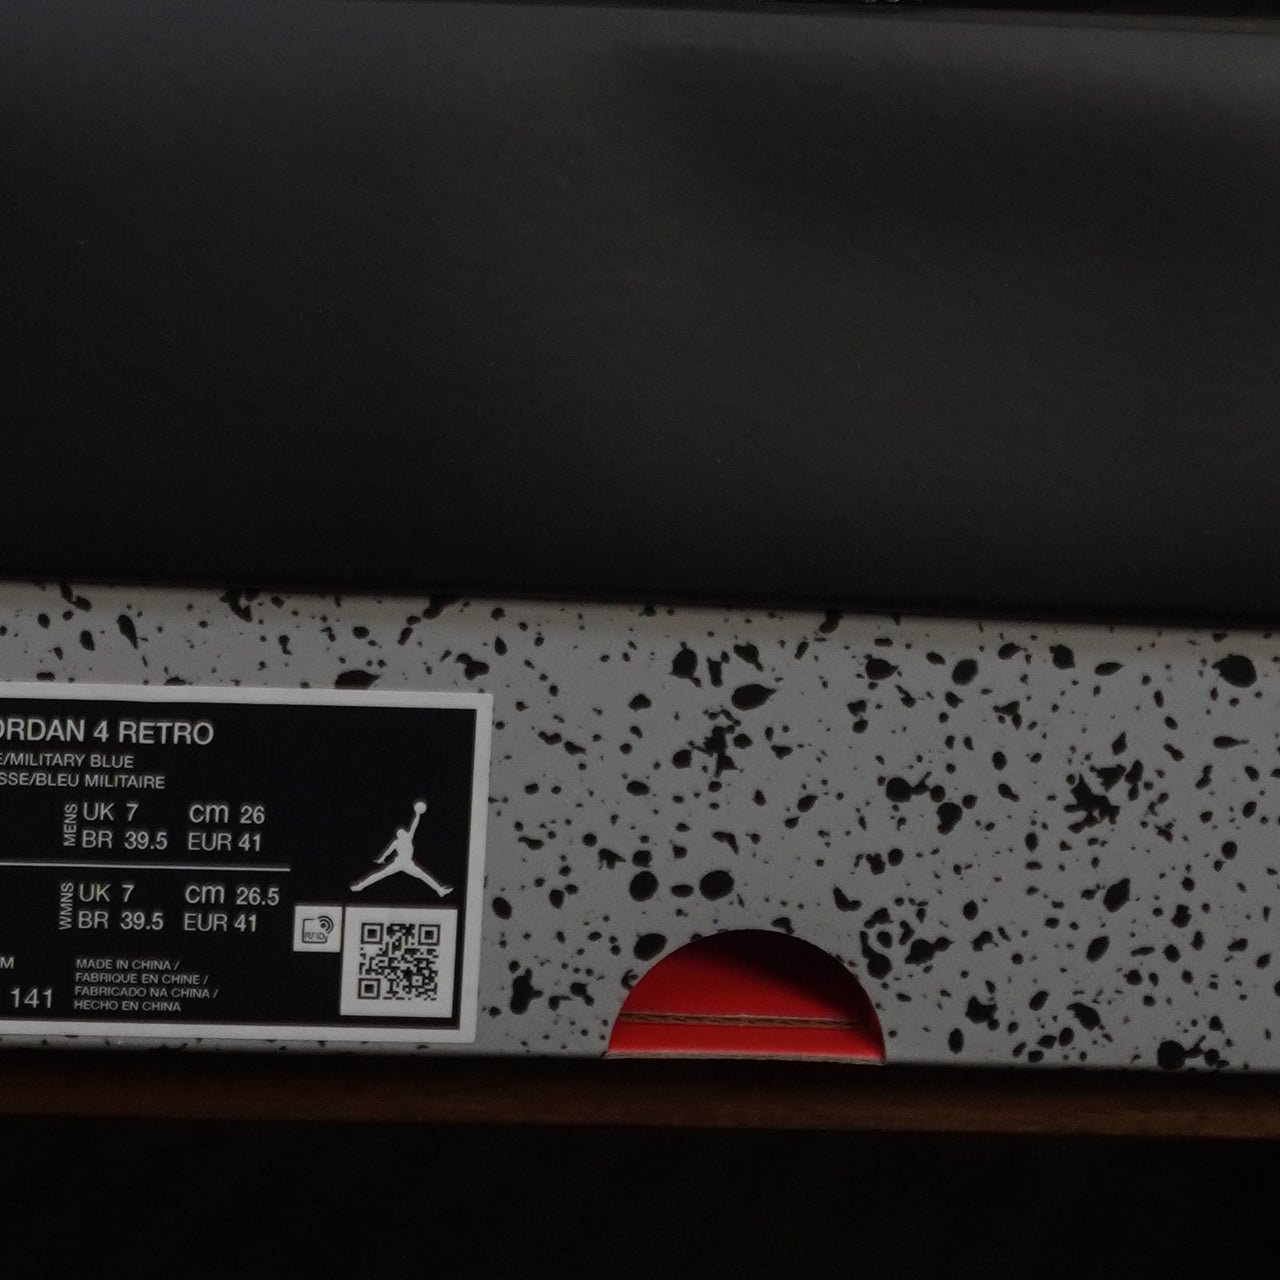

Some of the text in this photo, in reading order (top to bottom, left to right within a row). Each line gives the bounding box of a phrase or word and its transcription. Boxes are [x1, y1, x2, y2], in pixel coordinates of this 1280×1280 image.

[93, 720, 109, 743] 4
[119, 721, 215, 745] RETRO
[90, 754, 134, 768] BLUE
[85, 774, 166, 789] MILITAIRE
[83, 802, 140, 822] UK 7
[240, 805, 266, 824] 26
[63, 803, 78, 847] MENS
[82, 830, 168, 850] BR 39.5
[188, 832, 262, 852] EUR 41
[79, 883, 135, 903] UK 7
[235, 887, 280, 906] 26.5
[58, 882, 74, 930] WMNS
[78, 911, 164, 930] BR 39.5
[183, 913, 258, 932] EUR 41
[304, 932, 326, 940] RFID
[75, 959, 112, 970] MADE
[116, 960, 129, 970] IN
[132, 960, 171, 971] CHINA
[75, 972, 138, 984] FABRIQUE
[142, 973, 158, 984] EN
[162, 974, 200, 985] CHINE
[10, 988, 53, 1008] 141
[74, 986, 147, 997] FABRICADO
[150, 987, 168, 998] NA
[171, 988, 210, 999] CHINA
[74, 1000, 181, 1012] HECHO EN CHINA
